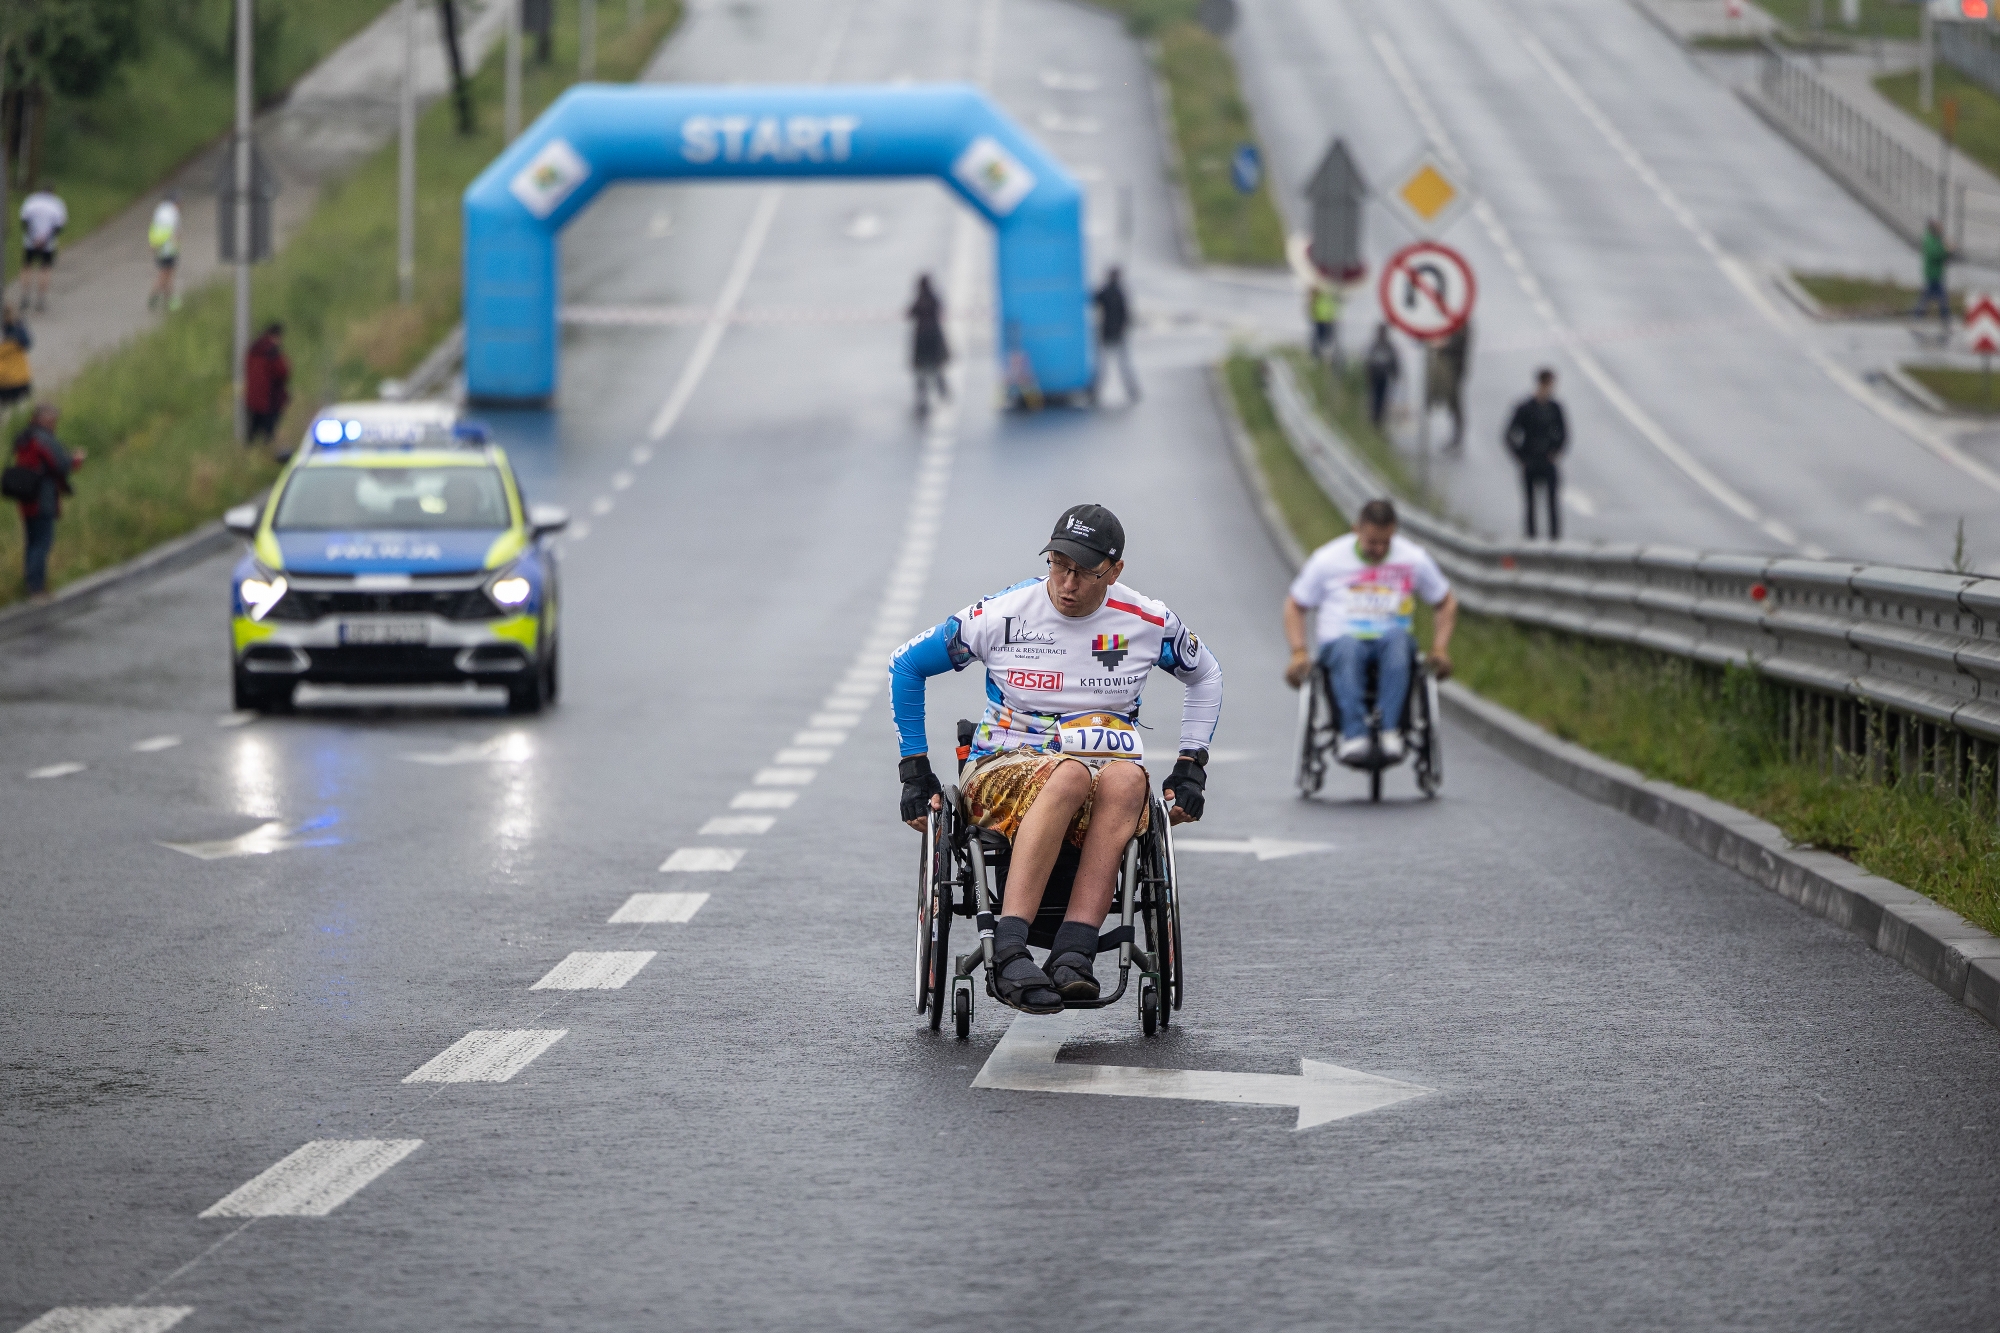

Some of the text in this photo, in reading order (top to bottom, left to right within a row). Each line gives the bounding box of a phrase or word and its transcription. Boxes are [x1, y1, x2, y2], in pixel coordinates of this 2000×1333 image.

[681, 115, 860, 163] START
[1002, 615, 1056, 644] Likus
[1008, 671, 1061, 690] rastal
[1077, 728, 1135, 752] 1700
